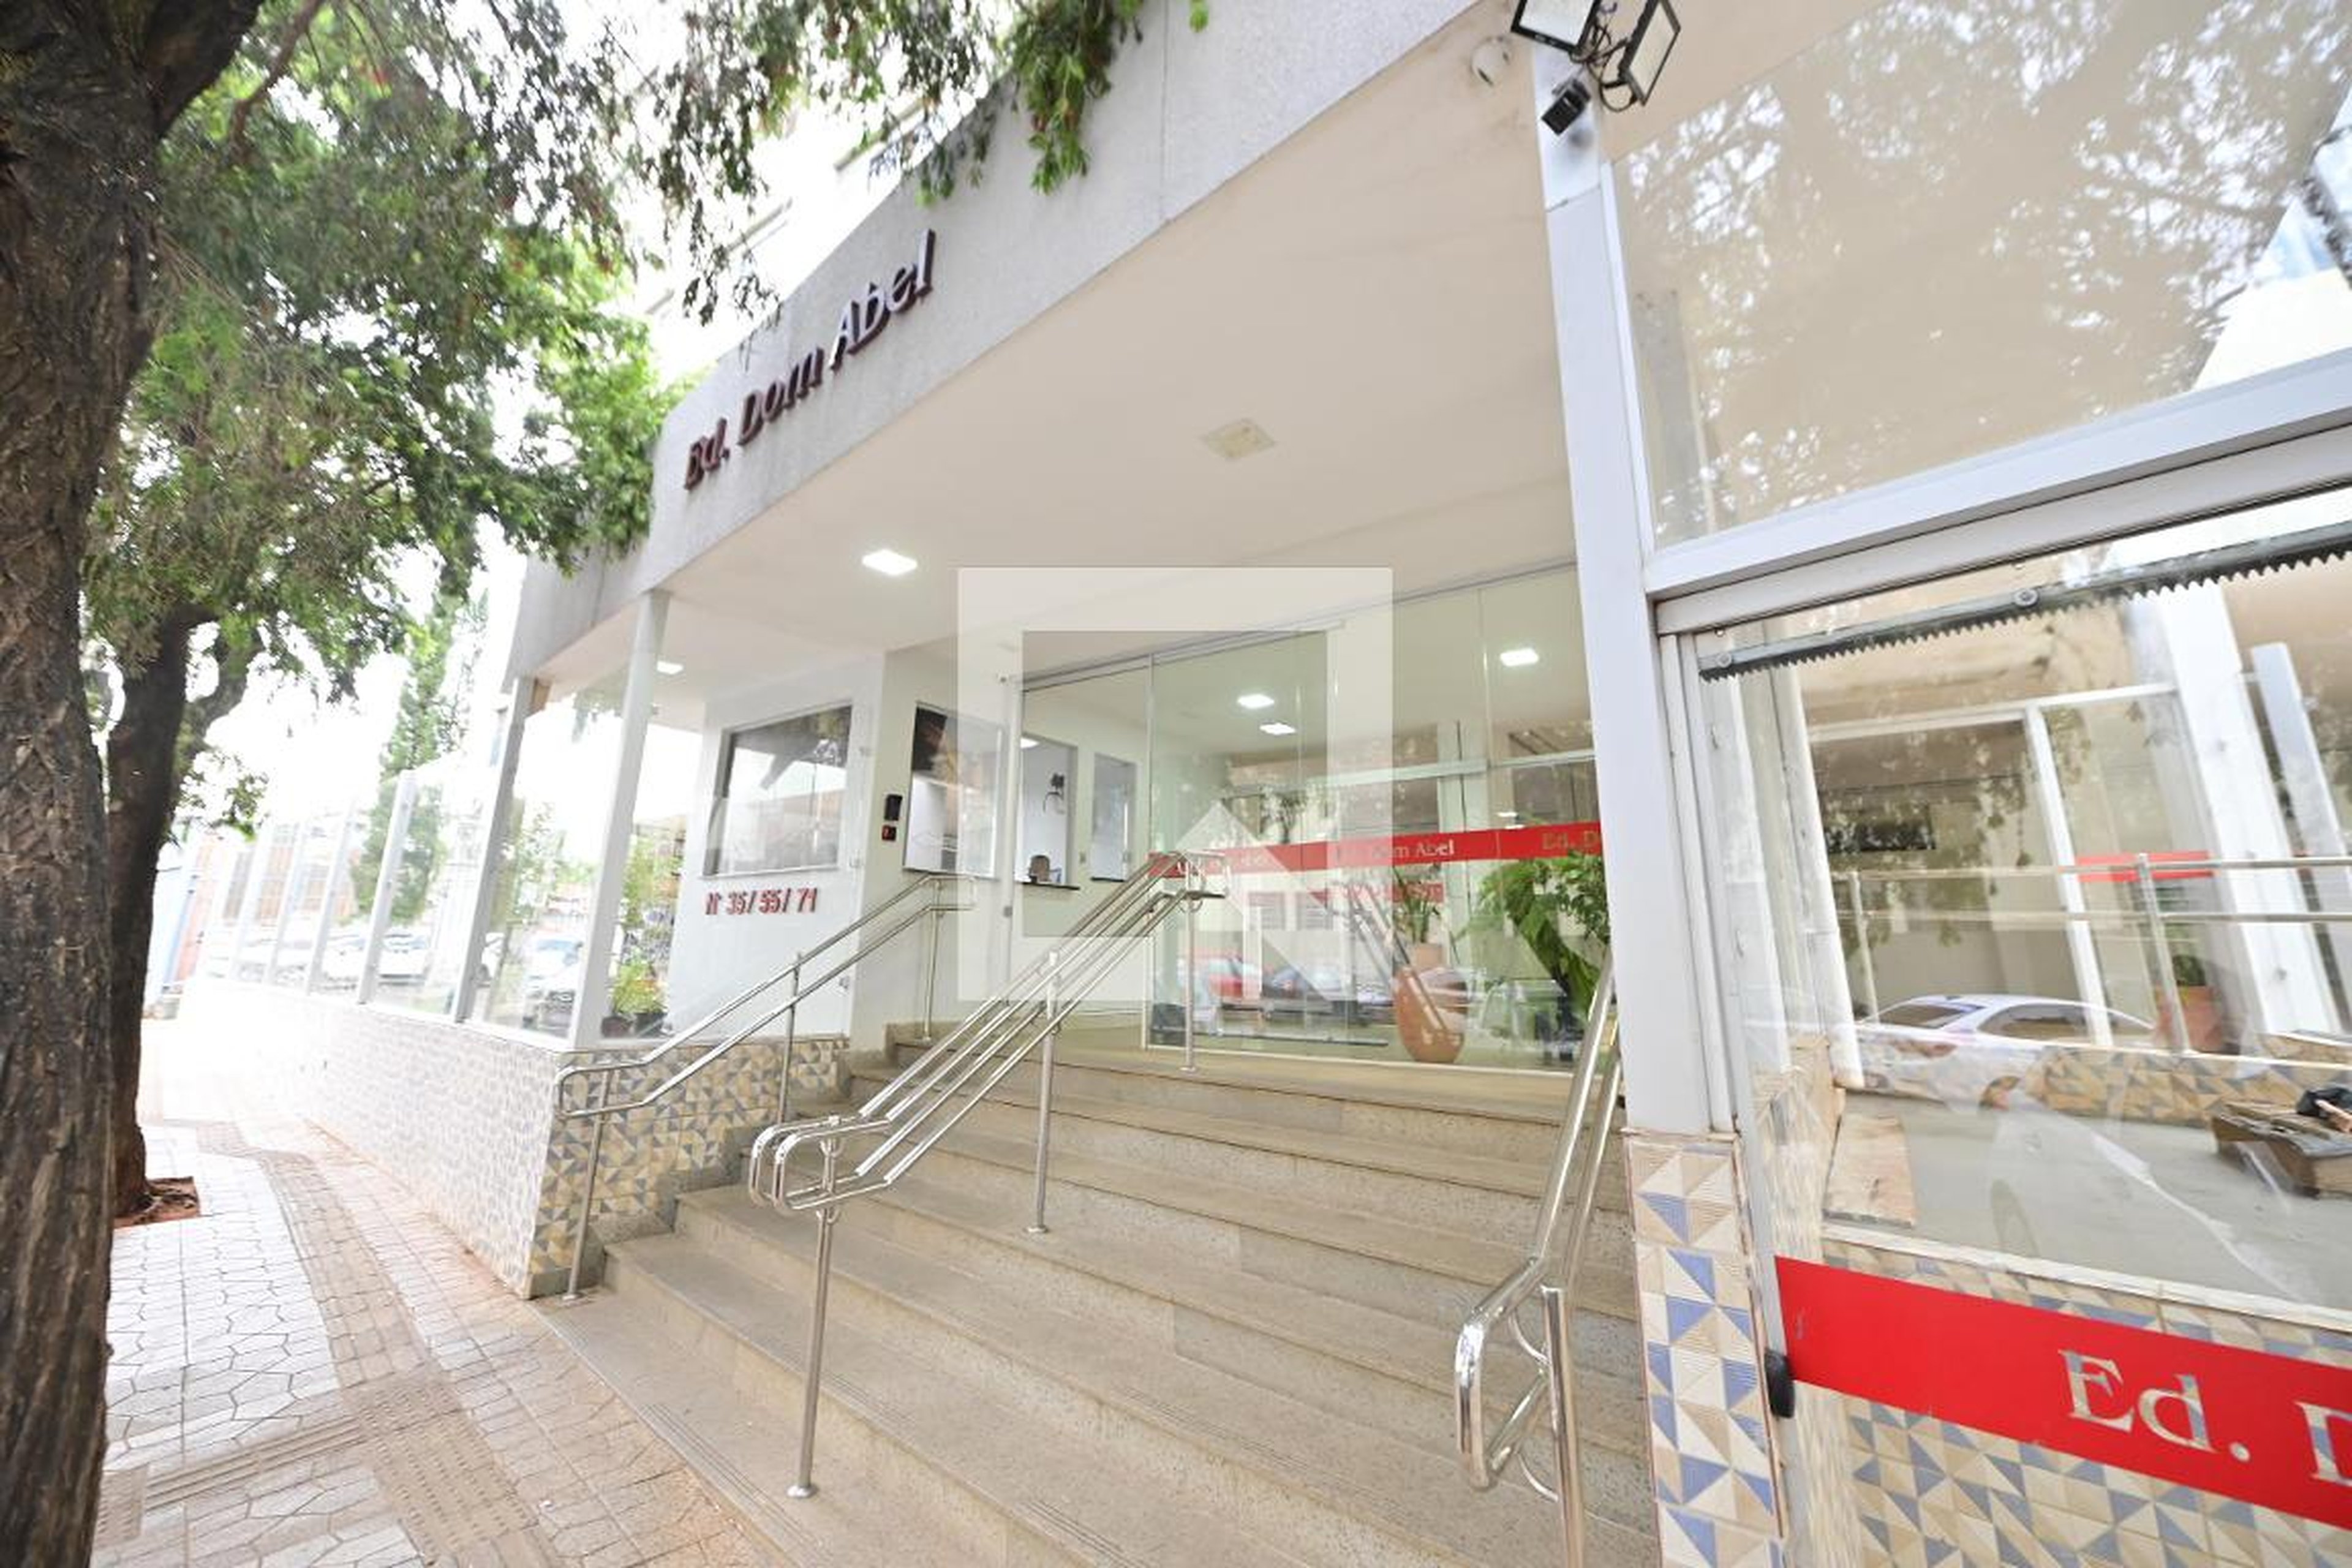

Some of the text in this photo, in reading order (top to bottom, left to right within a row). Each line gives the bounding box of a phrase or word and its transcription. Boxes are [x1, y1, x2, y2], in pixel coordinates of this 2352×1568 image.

[684, 228, 936, 490] Ed. Dom Abel
[2057, 1349, 2251, 1463] Ed.
